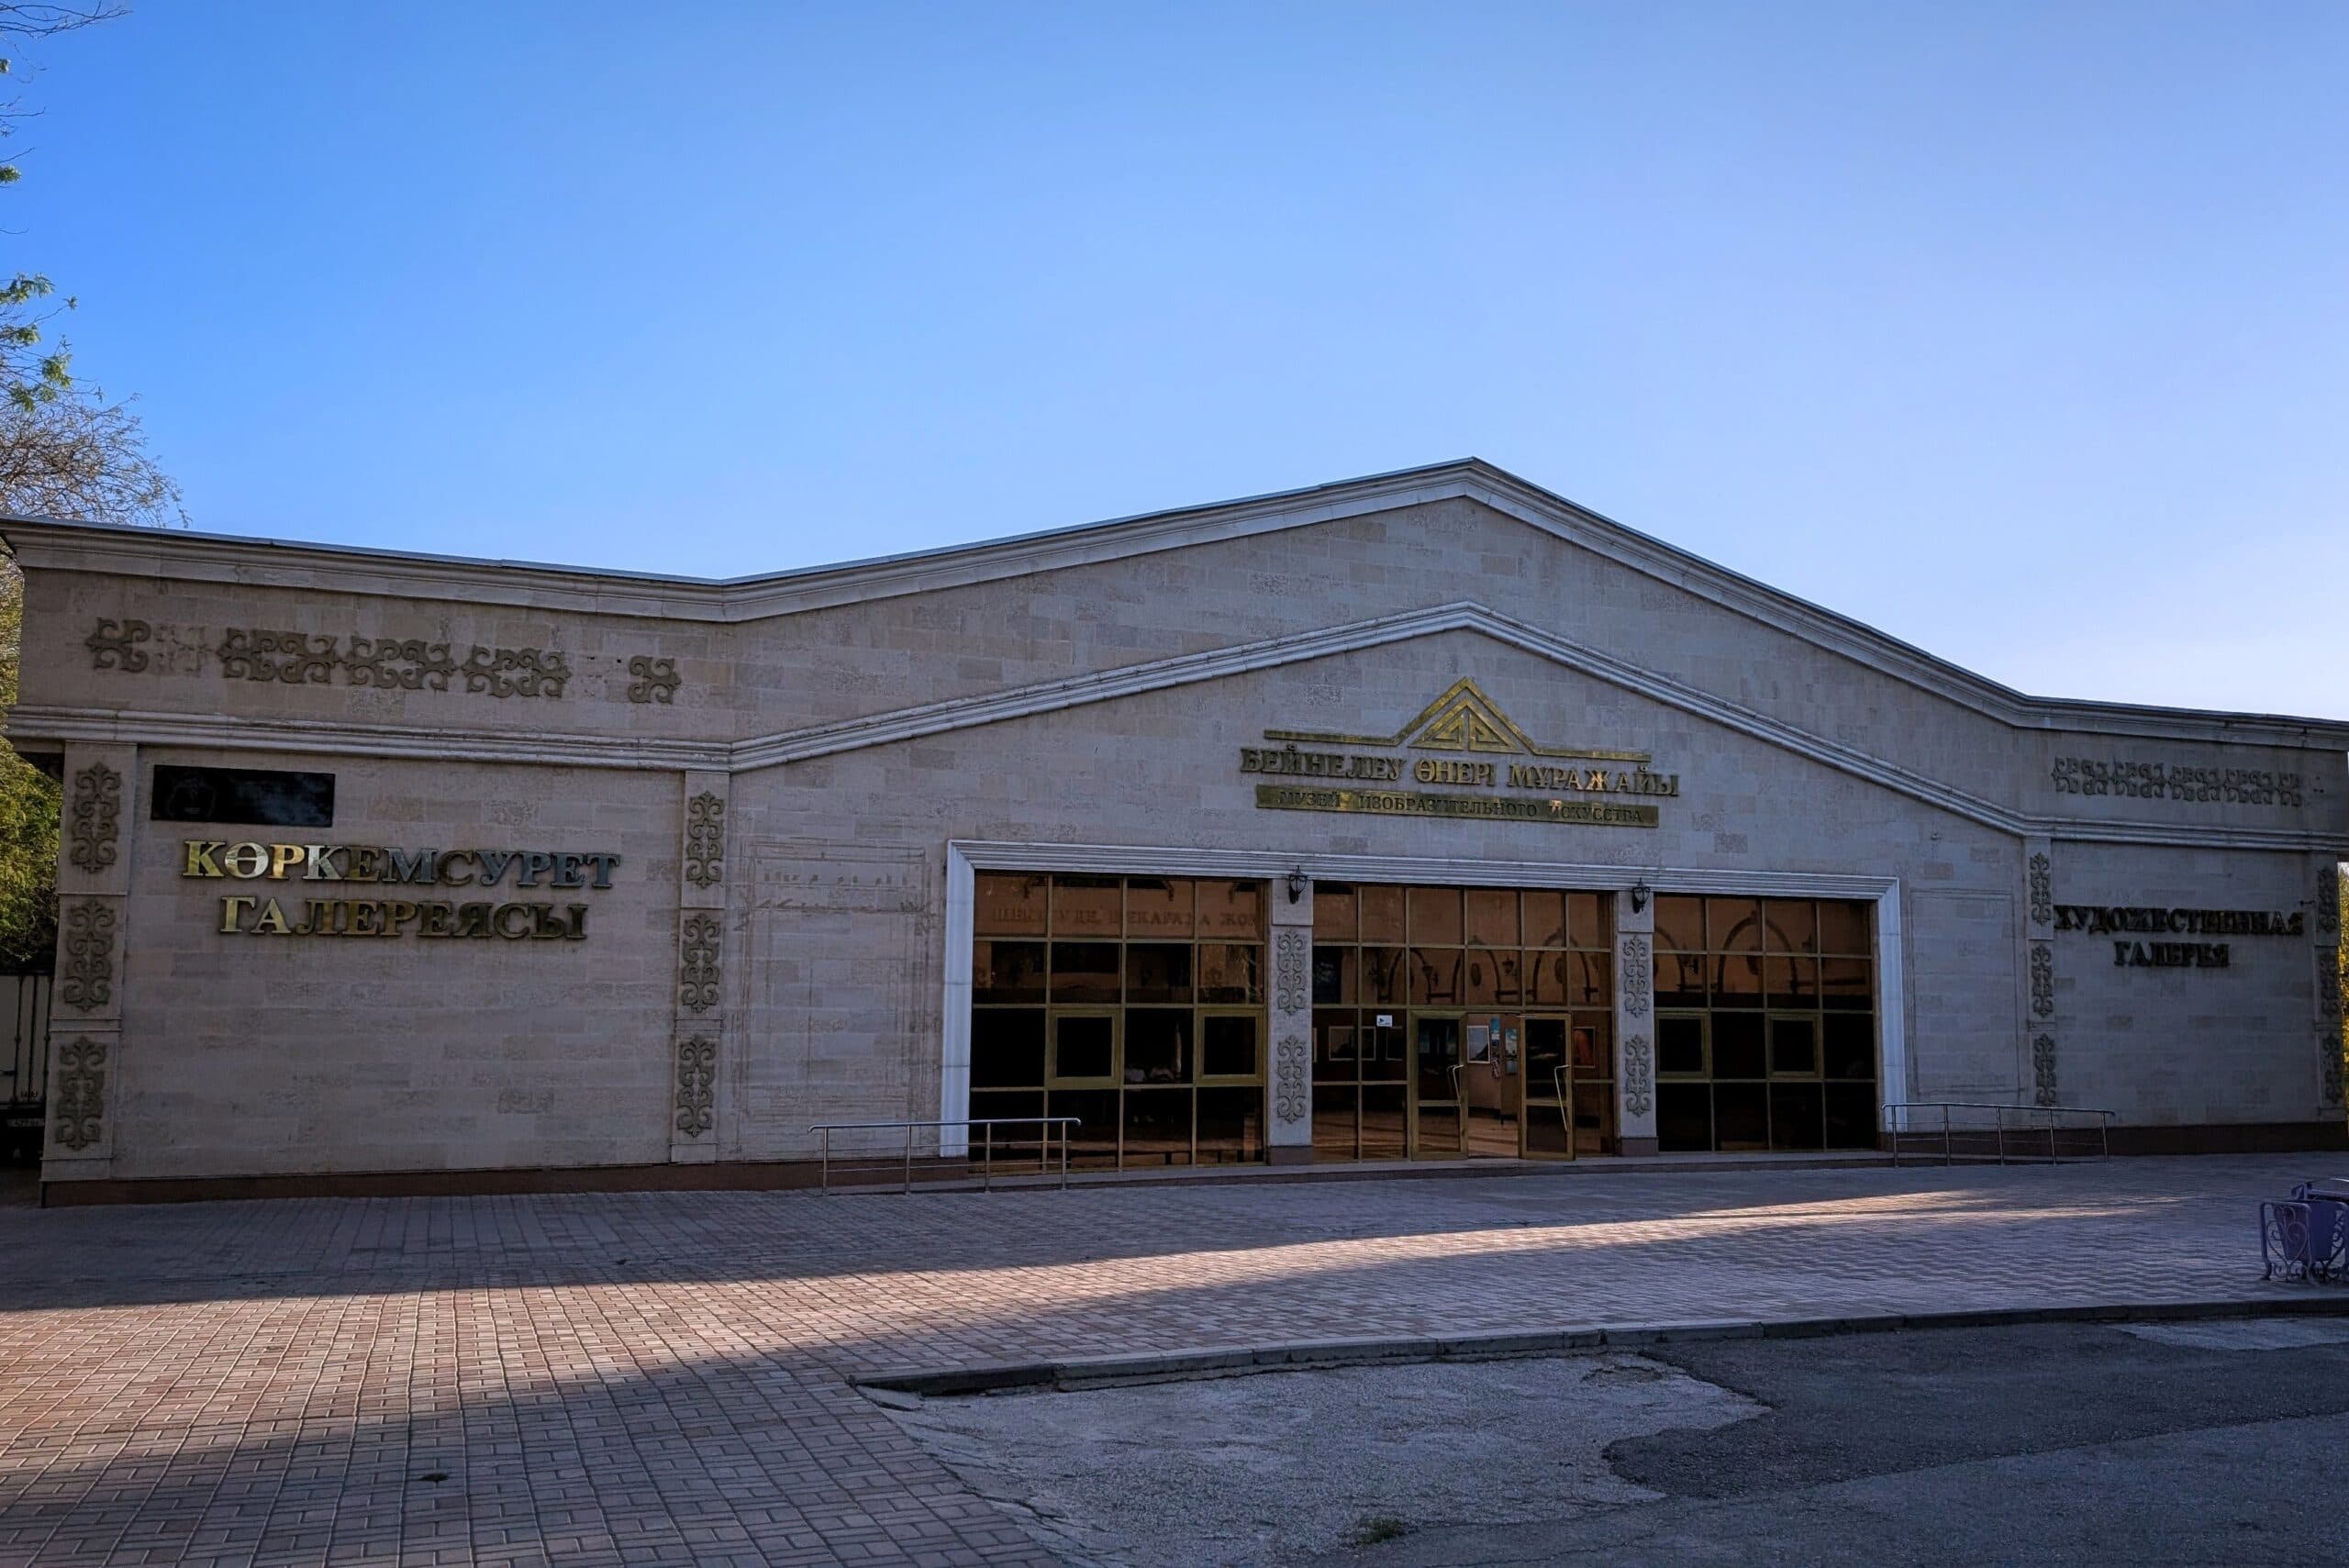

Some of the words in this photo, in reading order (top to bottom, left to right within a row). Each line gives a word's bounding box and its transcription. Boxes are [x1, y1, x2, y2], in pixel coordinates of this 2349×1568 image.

[1241, 744, 1407, 781] БЕЙНЕЛЕУ
[1414, 758, 1497, 787] ӨНЕРІ
[1507, 762, 1679, 796] МҰРАЖАЙЫ
[1279, 790, 1341, 808] МУЗЕЙ
[1359, 795, 1538, 817] ИЗОБРАЗИТЕЛЬНОГО
[1549, 804, 1644, 823] ИСКУССТВА
[182, 839, 620, 888] КӨРКЕМСУРЕТ
[219, 895, 588, 940] ГАЛЕРЕЯСЫ
[2054, 905, 2304, 936] ХУДОЖЕСТВЕННАЯ
[2114, 940, 2231, 967] ГАЛЕРЕЯ
